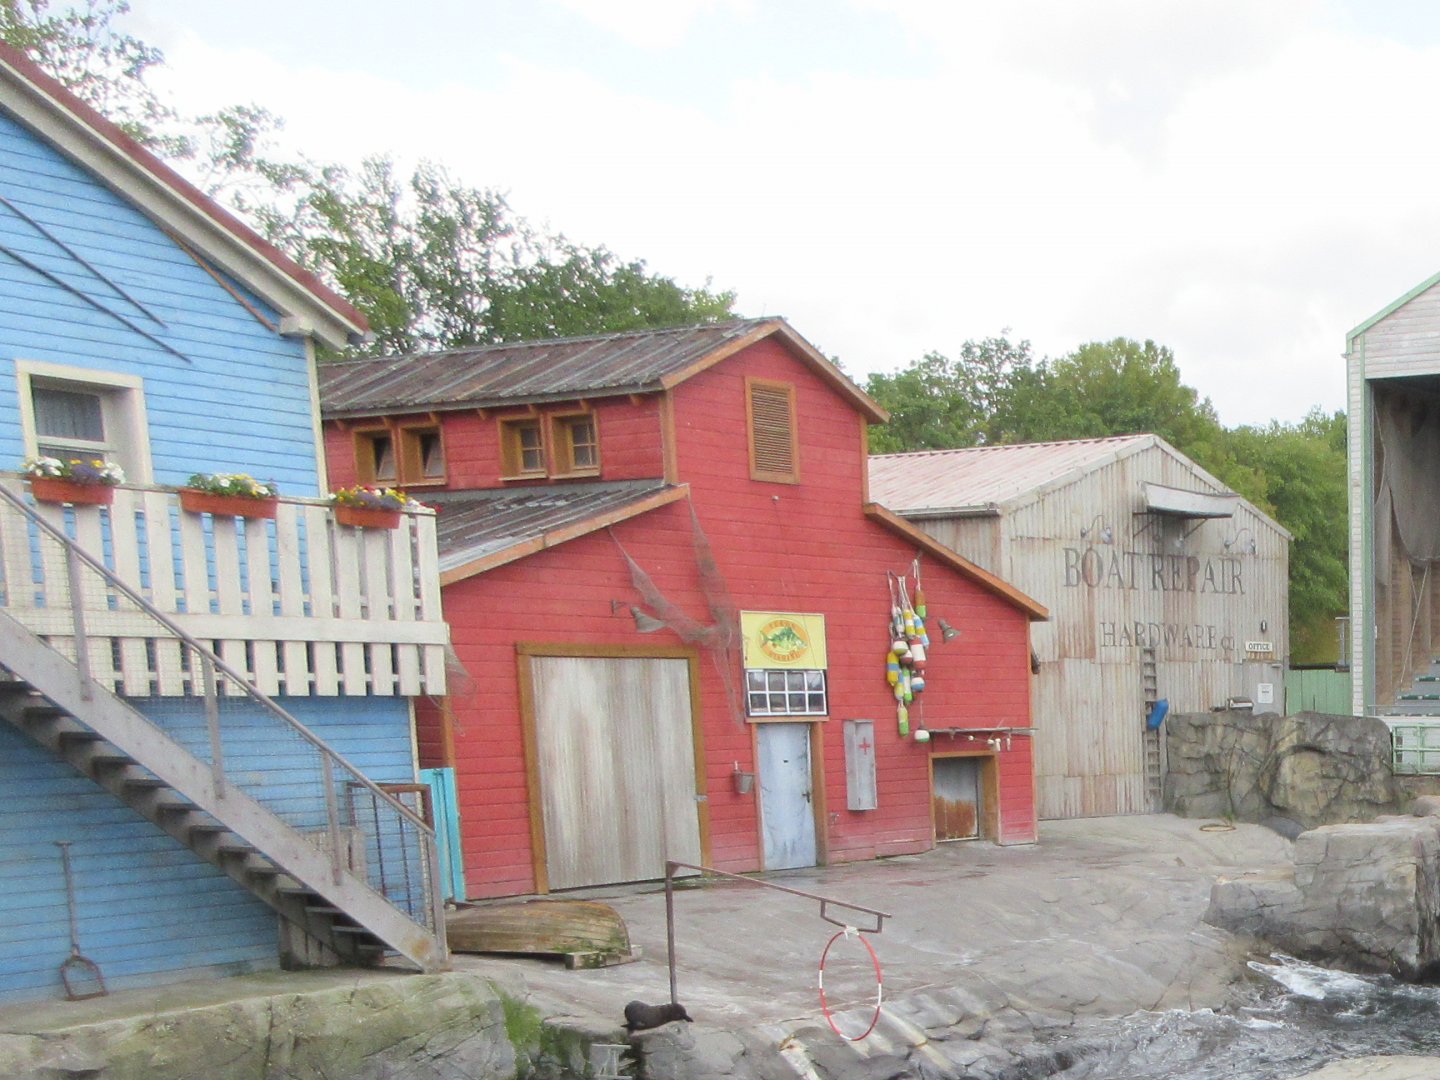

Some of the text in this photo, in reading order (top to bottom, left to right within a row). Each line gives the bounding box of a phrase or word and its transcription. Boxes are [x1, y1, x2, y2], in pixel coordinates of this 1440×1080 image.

[1063, 547, 1246, 595] BOAT REPAIR
[1100, 620, 1217, 650] HARDWARE
